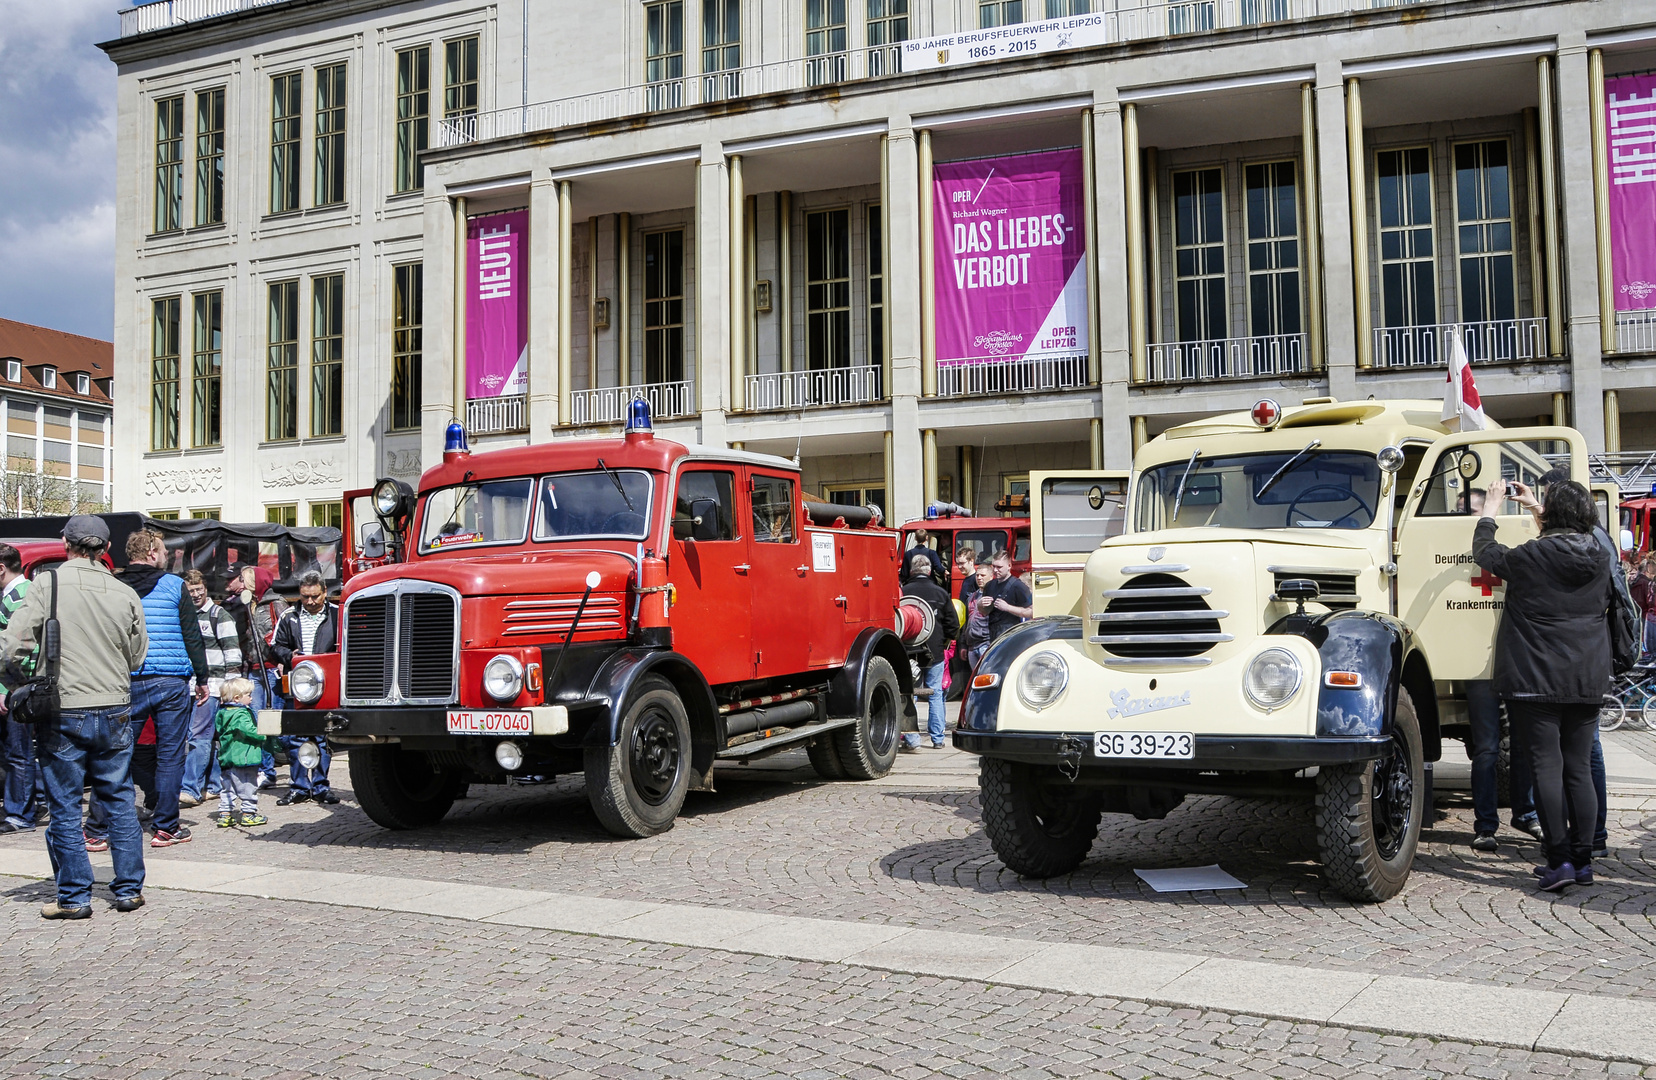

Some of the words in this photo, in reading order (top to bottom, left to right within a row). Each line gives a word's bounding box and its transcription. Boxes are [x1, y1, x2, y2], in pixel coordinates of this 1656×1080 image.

[905, 43, 920, 52] 150
[922, 38, 955, 50] JAHRE
[957, 22, 1060, 45] BERUFSFEUERWEHR
[1062, 16, 1102, 30] LEIPZIG
[967, 45, 996, 58] 1865
[1008, 39, 1037, 54] 2015
[1609, 88, 1656, 185] HEUTE
[952, 190, 972, 203] OPER
[952, 208, 980, 219] Richard
[980, 207, 1008, 217] Wagner
[953, 220, 993, 255] DAS
[997, 213, 1074, 251] LIEBES-
[479, 223, 511, 300] HEUTE
[953, 253, 1031, 290] VERBOT
[1052, 326, 1077, 337] OPER
[1041, 337, 1077, 349] LEIPZIG
[441, 534, 473, 543] Feuerwehr
[1446, 600, 1504, 610] Krankentran
[1106, 688, 1191, 720] Garant
[1099, 734, 1124, 755] SG
[1130, 734, 1191, 756] 39-23
